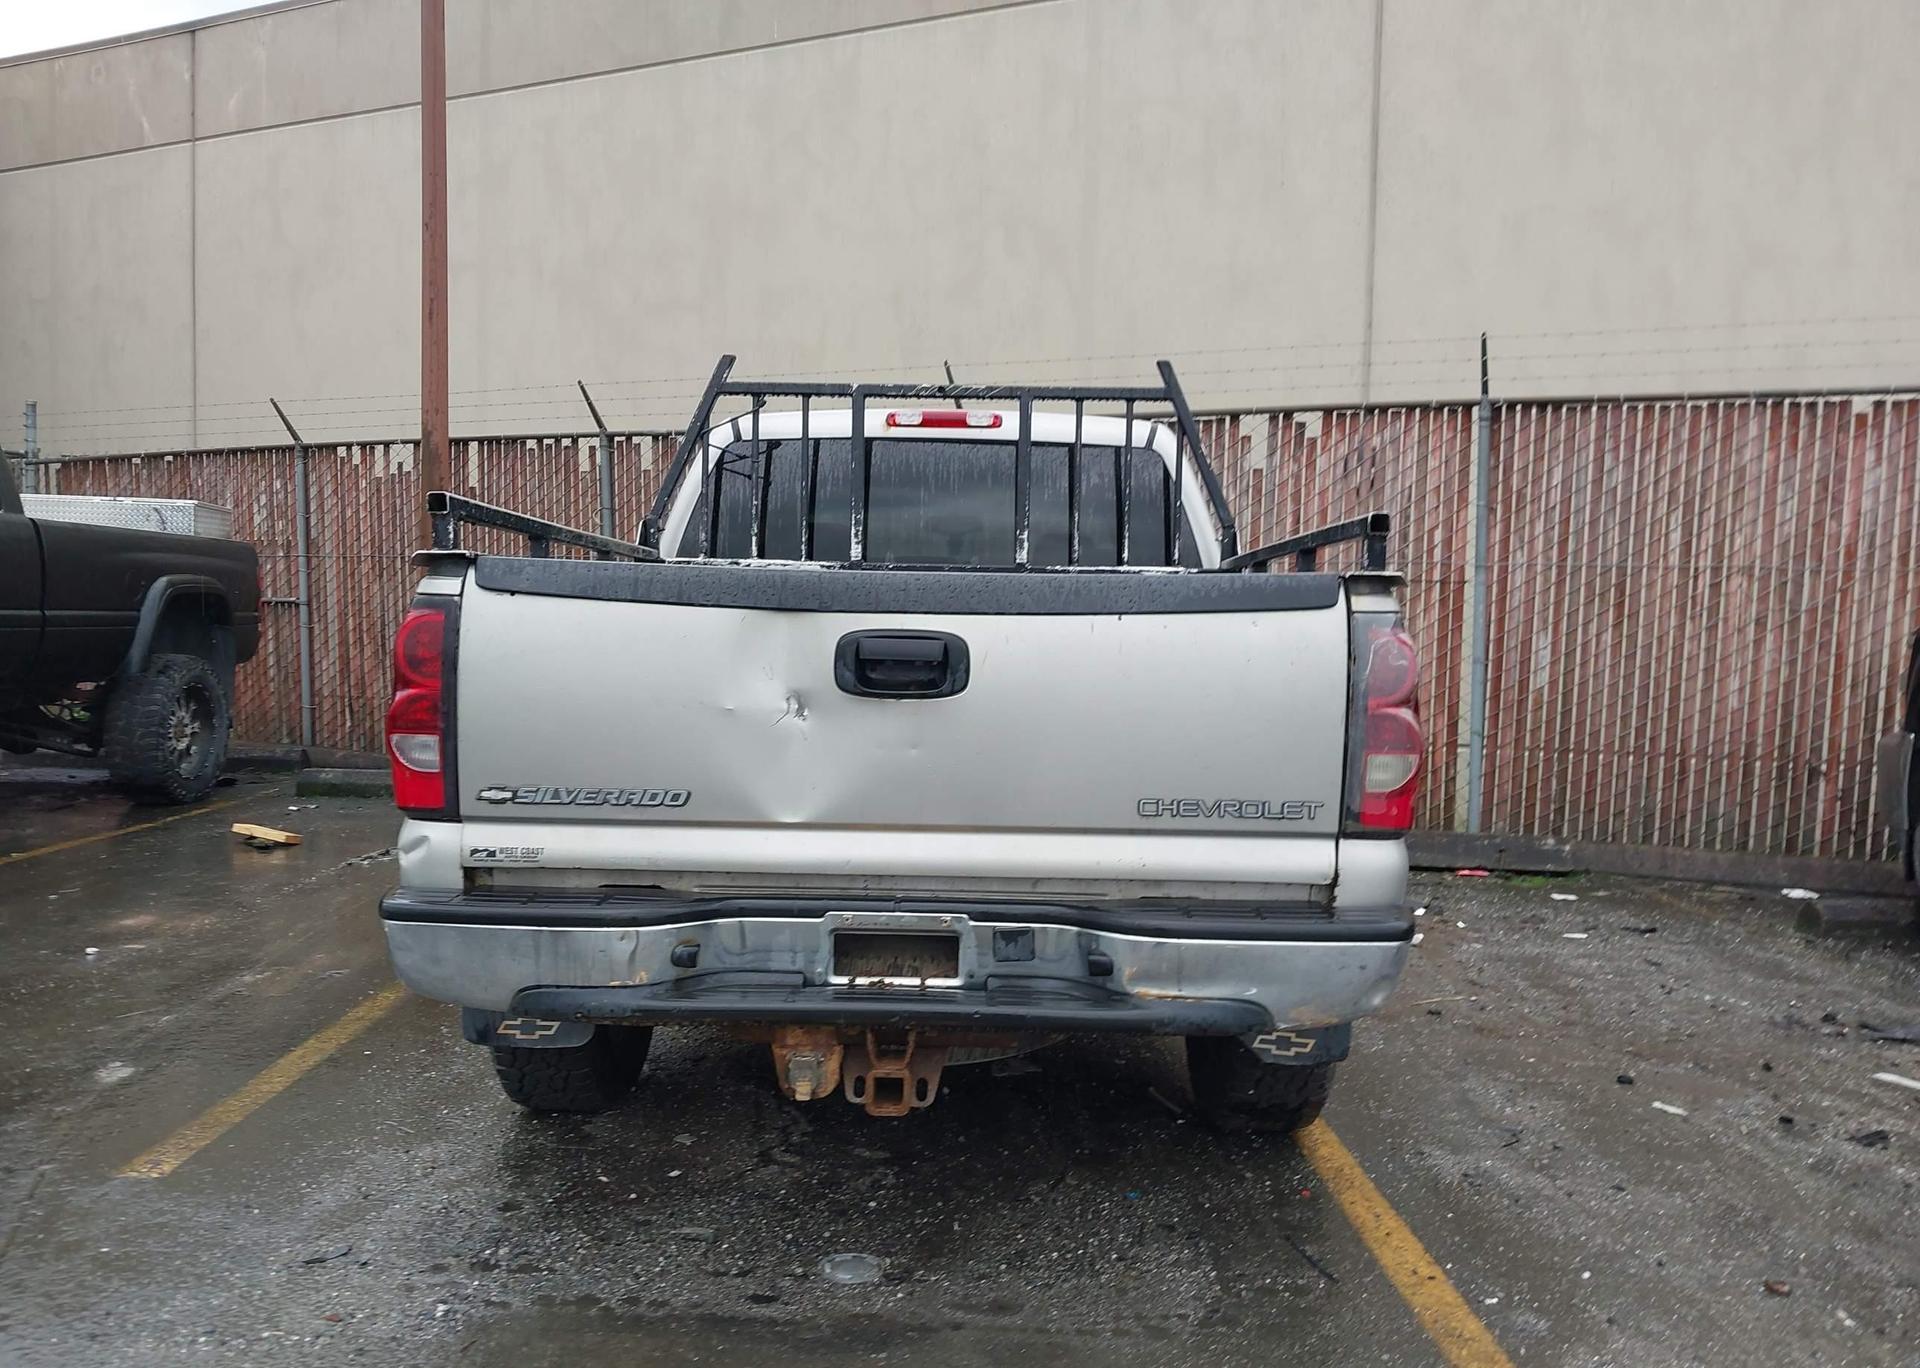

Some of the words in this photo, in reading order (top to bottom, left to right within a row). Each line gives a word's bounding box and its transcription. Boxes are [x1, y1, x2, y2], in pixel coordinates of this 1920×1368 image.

[514, 786, 692, 808] SILVERADO
[1137, 799, 1325, 820] CHEVROLET
[520, 847, 545, 856] COAST
